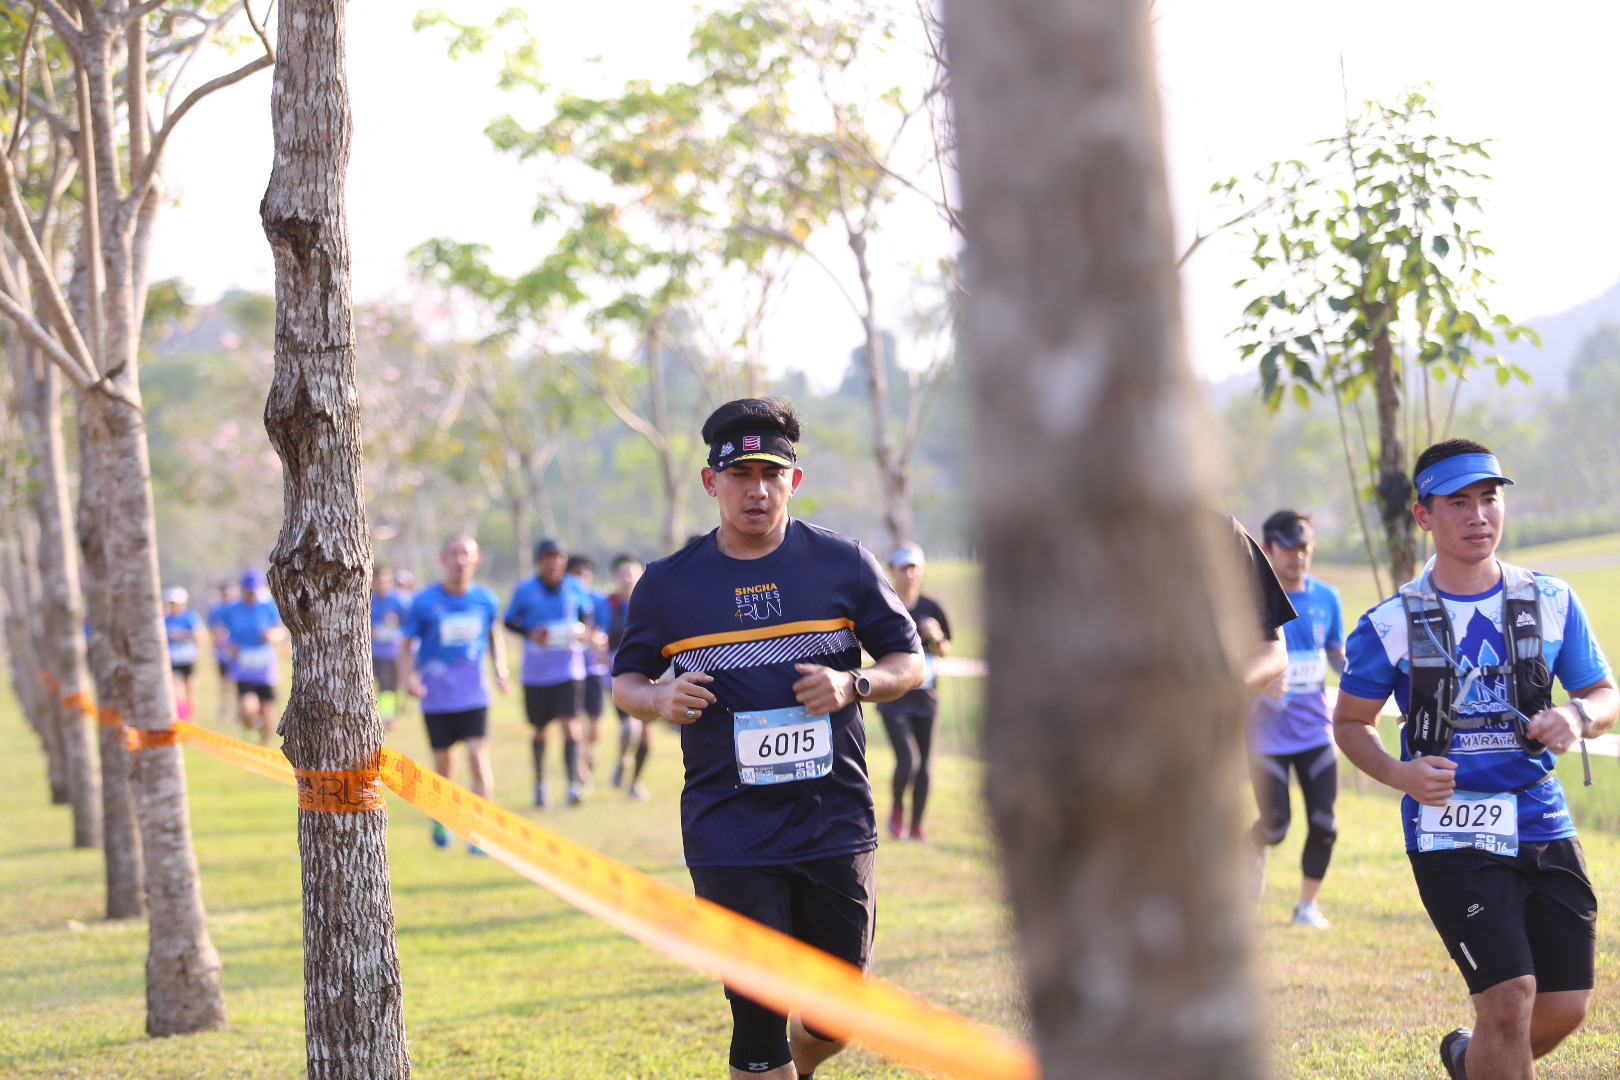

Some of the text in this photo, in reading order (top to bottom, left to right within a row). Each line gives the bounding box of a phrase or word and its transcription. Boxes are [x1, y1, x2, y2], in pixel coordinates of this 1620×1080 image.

[734, 582, 778, 596] SINGHA
[735, 590, 781, 605] SERIES
[758, 728, 815, 758] 6015
[1439, 803, 1502, 827] 6029
